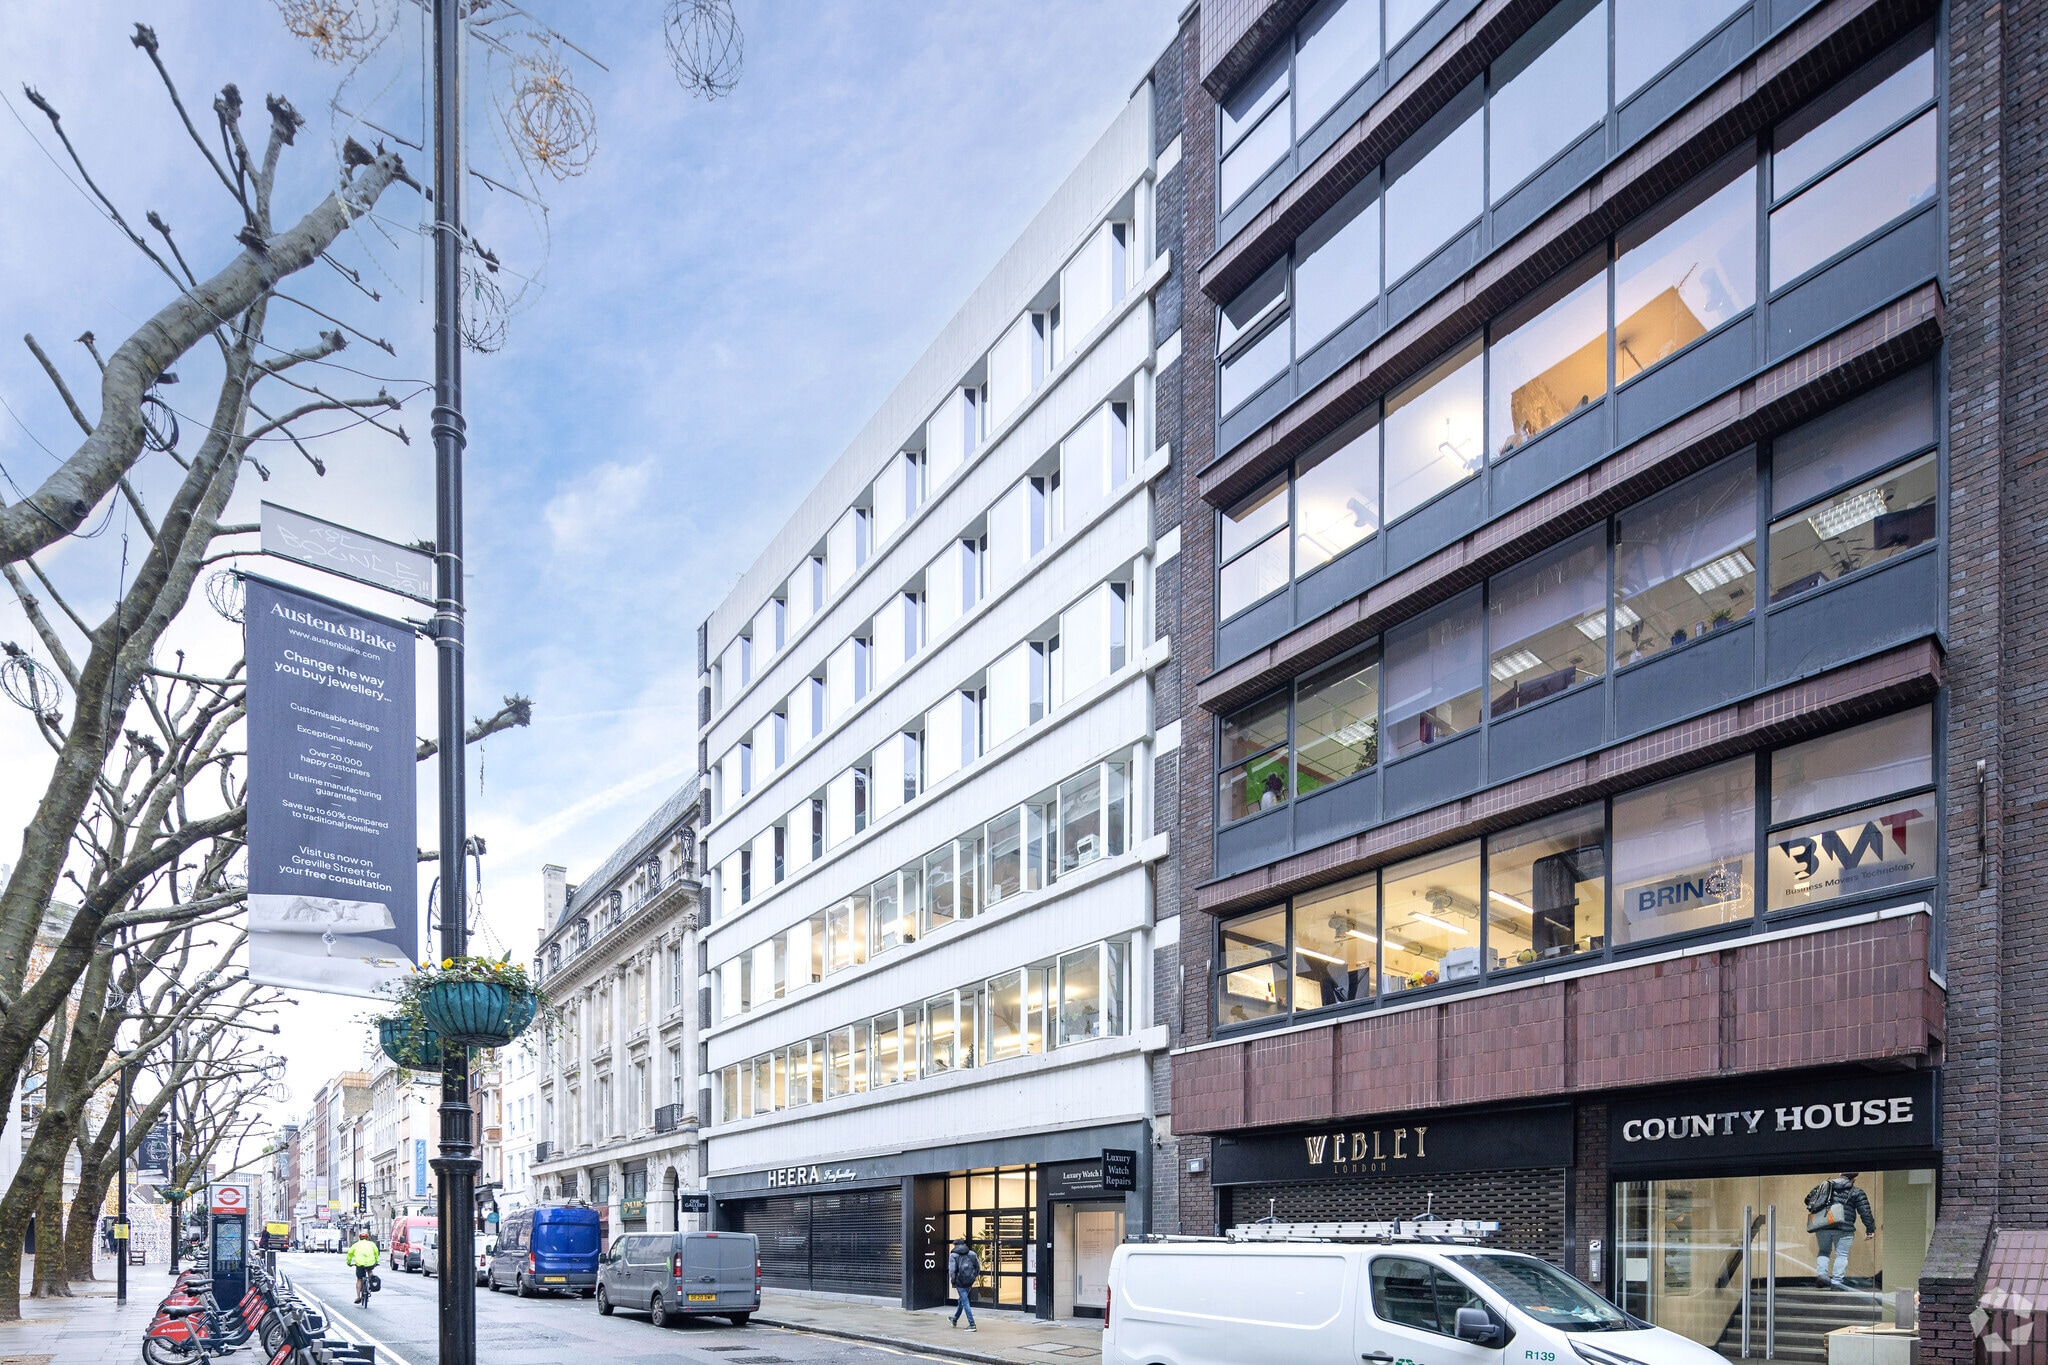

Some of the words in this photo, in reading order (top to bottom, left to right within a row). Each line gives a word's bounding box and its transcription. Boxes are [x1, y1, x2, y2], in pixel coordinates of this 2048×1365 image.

[270, 602, 397, 652] Austen&Blake
[288, 628, 381, 661] www.austenblake.com
[274, 661, 300, 675] you
[302, 667, 327, 684] buy
[284, 649, 335, 672] Change
[337, 665, 357, 679] the
[359, 673, 385, 688] way
[290, 702, 348, 724] Customisable
[348, 718, 380, 733] designs
[297, 725, 346, 744] Exceptional
[346, 737, 373, 752] quality
[300, 754, 327, 768] happy
[328, 761, 371, 778] customers
[309, 748, 330, 759] Over
[289, 772, 323, 786] Lifetime
[324, 780, 382, 800] manufacturing
[315, 787, 357, 803] guarantee
[282, 799, 303, 810] Save
[304, 805, 316, 814] up
[316, 806, 326, 815] to
[327, 809, 346, 820] 60%
[347, 815, 389, 829] compared
[292, 810, 302, 818] to
[303, 813, 344, 828] traditional
[344, 822, 380, 836] jewellers
[292, 855, 331, 870] Greville
[333, 863, 365, 877] Street
[366, 869, 381, 880] for
[299, 845, 322, 858] Visit
[324, 851, 336, 860] us
[337, 854, 360, 865] now
[360, 859, 373, 868] on
[279, 864, 304, 876] your
[305, 868, 327, 880] free
[328, 874, 392, 893] consultation
[1785, 882, 1823, 897] Business
[1825, 874, 1859, 888] Movers
[1862, 862, 1915, 879] Technology
[1622, 1109, 1764, 1142] COUNTY
[1775, 1097, 1914, 1132] HOUSE
[1106, 1152, 1131, 1164] Luxury
[1305, 1127, 1428, 1164] WEBLEY
[768, 1166, 820, 1187] HEERA
[1063, 1172, 1081, 1180] Luxury
[1082, 1170, 1099, 1178] Watch
[1108, 1165, 1129, 1175] Watch
[1334, 1163, 1386, 1174] LONDON
[1106, 1176, 1132, 1187] Repairs
[1525, 1350, 1556, 1362] R139
